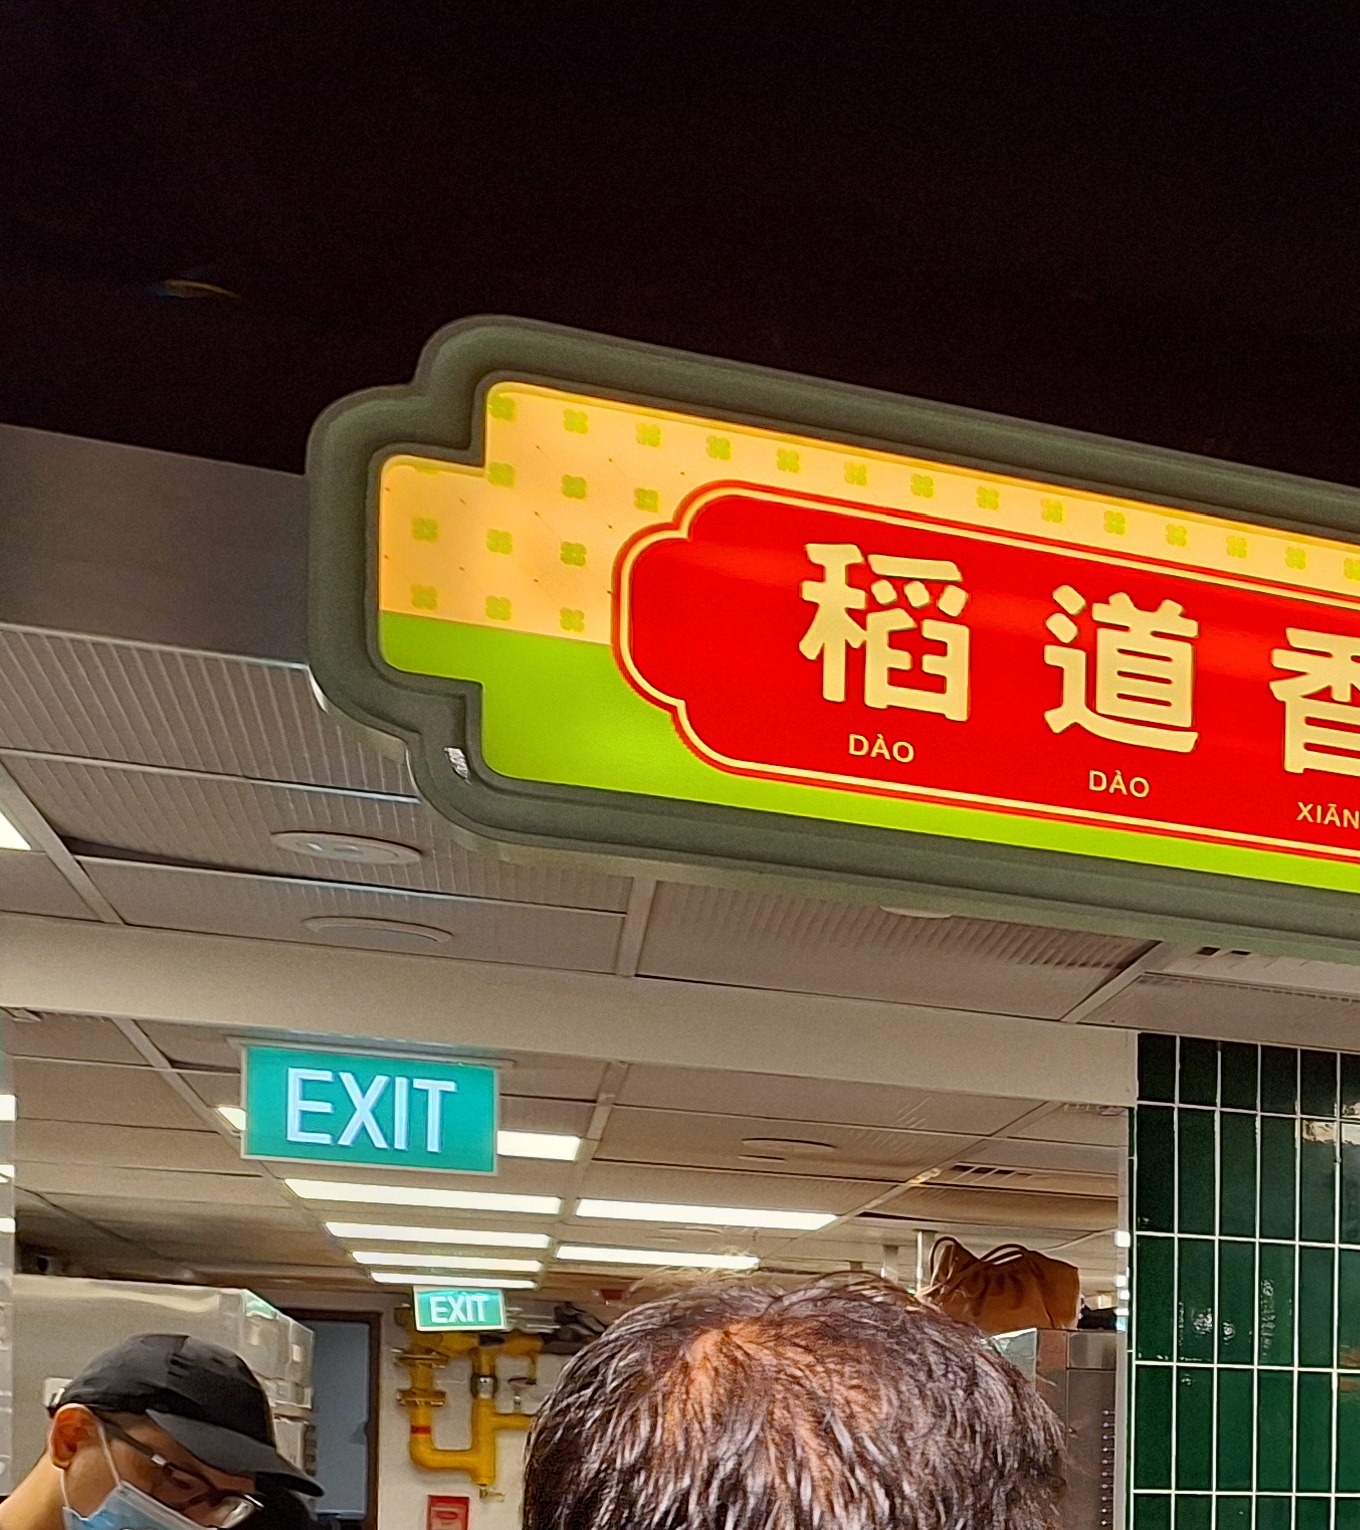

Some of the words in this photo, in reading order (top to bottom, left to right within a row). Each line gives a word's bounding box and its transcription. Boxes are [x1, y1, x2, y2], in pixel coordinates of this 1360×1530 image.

[848, 734, 914, 763] DÀO
[1088, 770, 1150, 798] DÀO
[285, 1066, 457, 1153] EXIT
[430, 1294, 487, 1324] EXIT
